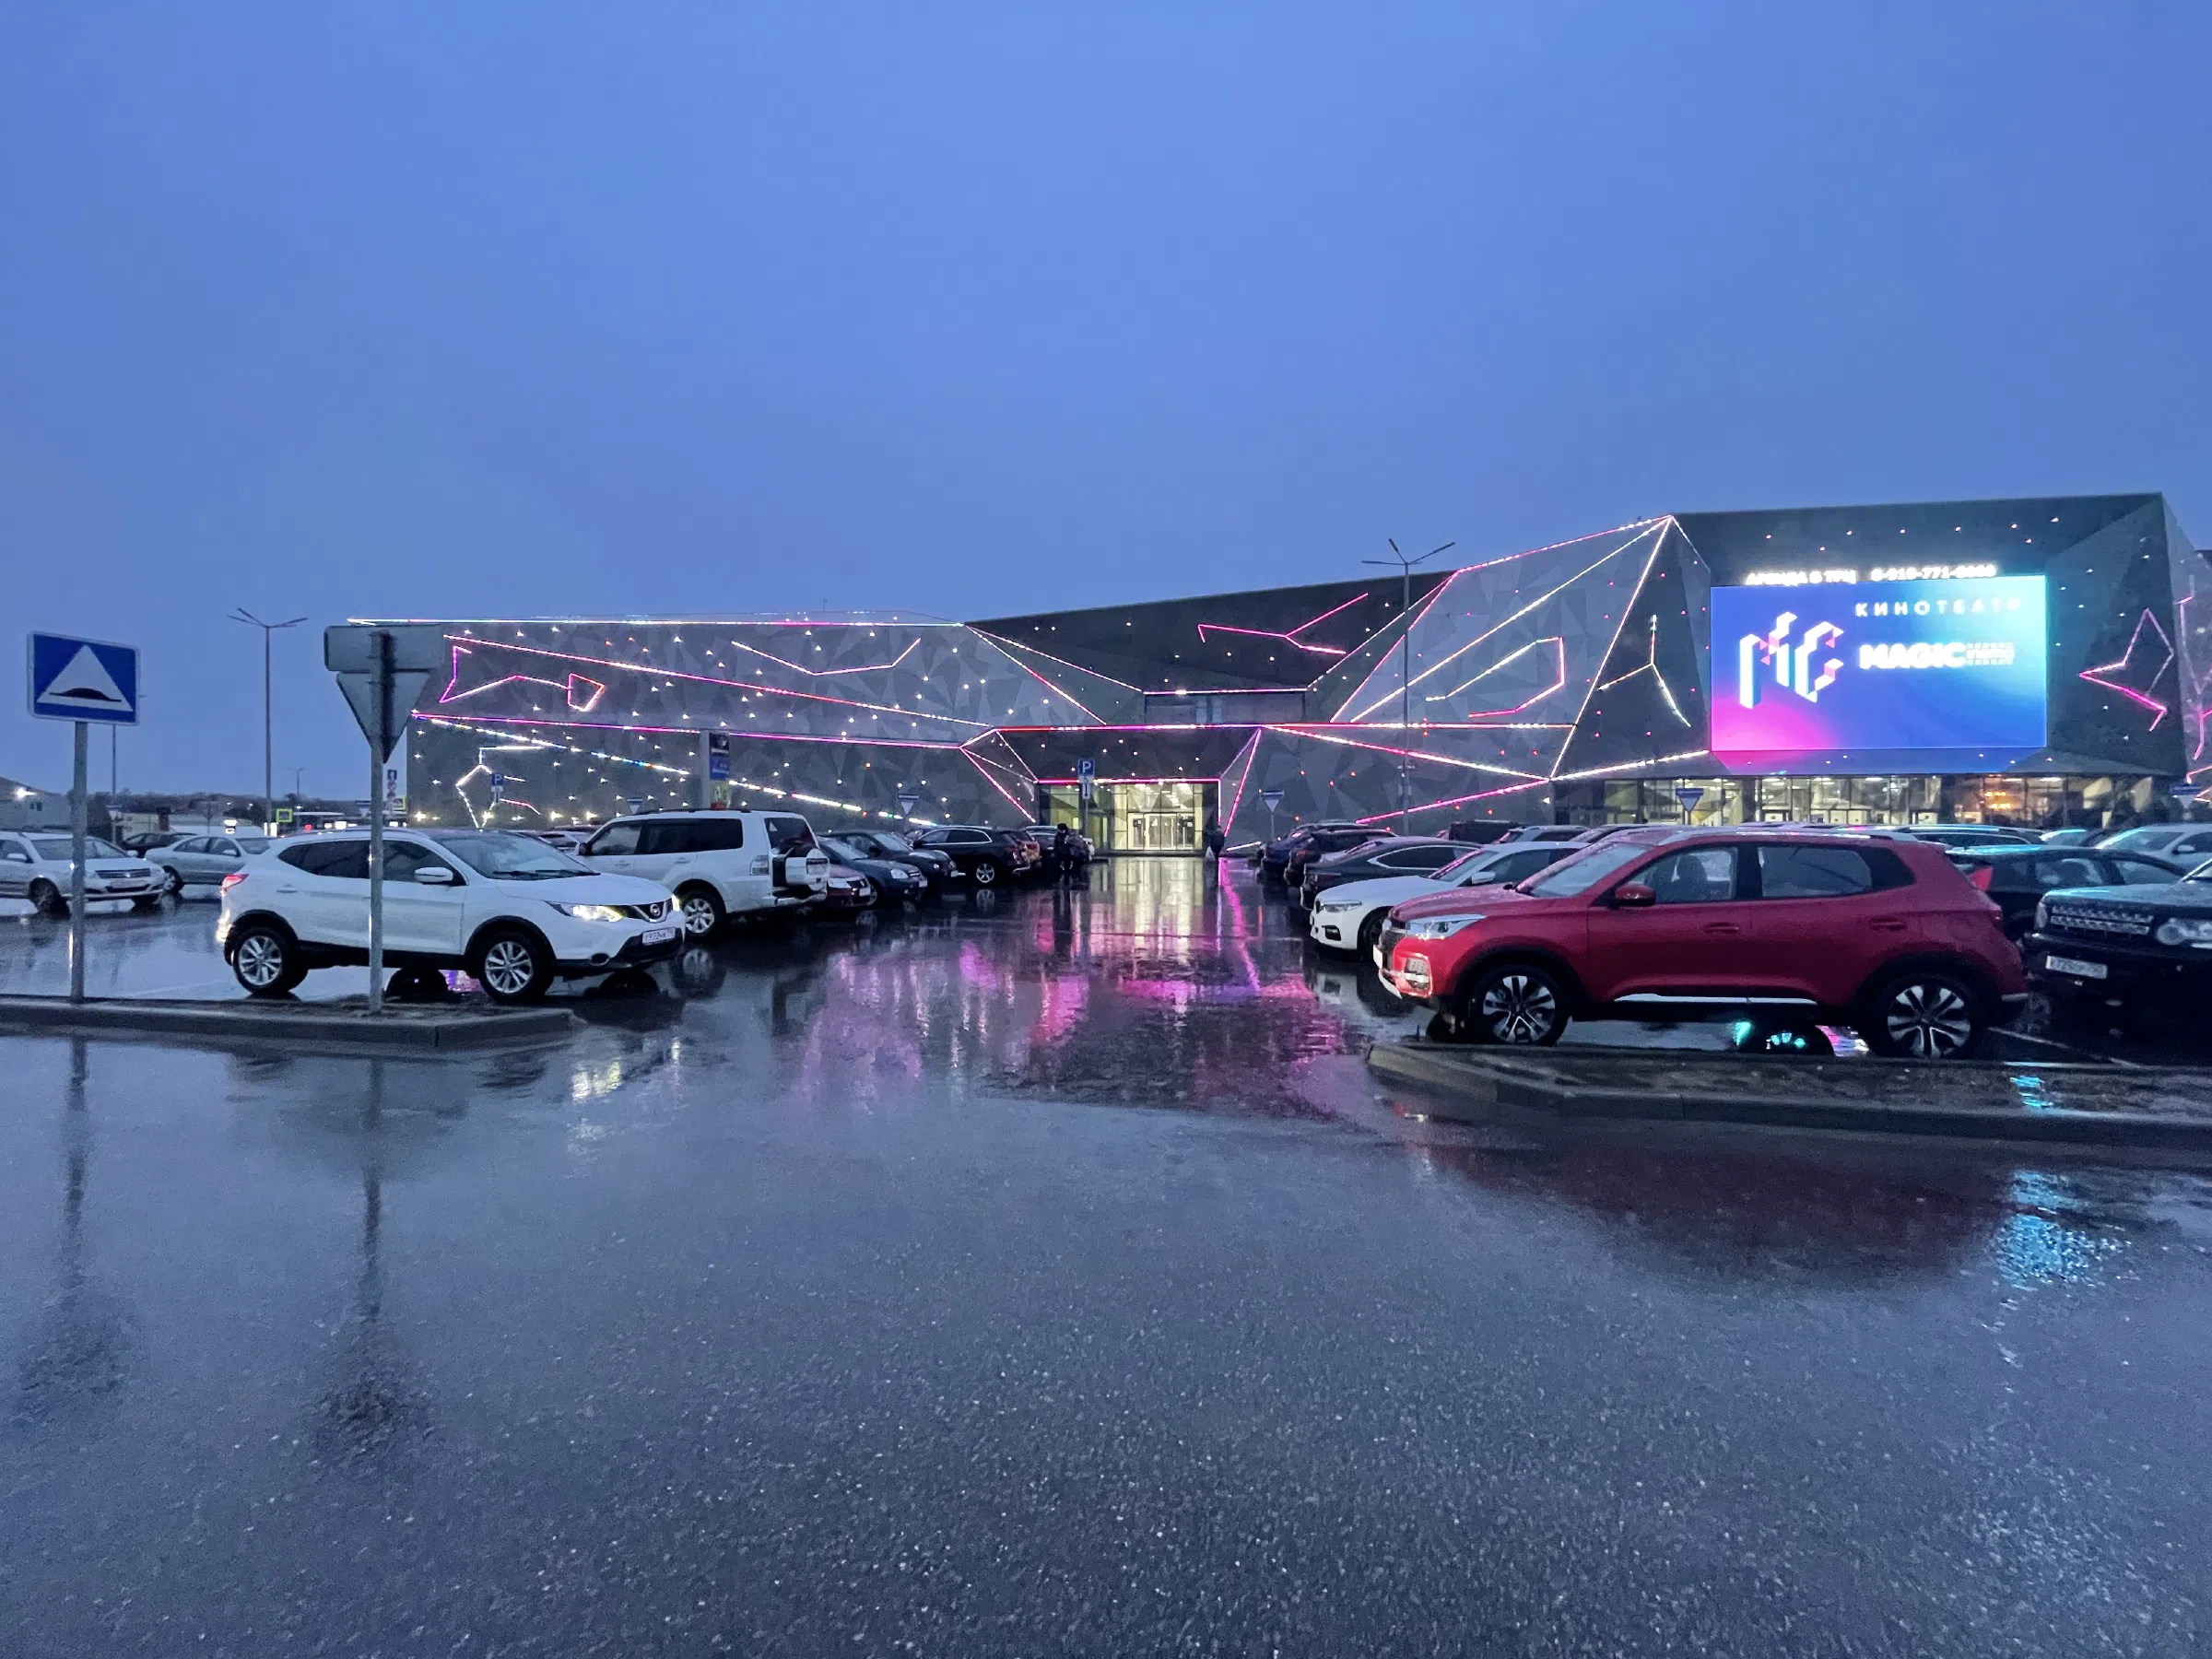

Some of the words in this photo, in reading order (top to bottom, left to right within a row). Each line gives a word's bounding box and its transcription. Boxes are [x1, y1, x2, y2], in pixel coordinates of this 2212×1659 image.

[1855, 598, 2021, 617] КИНОТЕАТР
[1859, 642, 1967, 669] MAGIC
[1082, 761, 1091, 773] P
